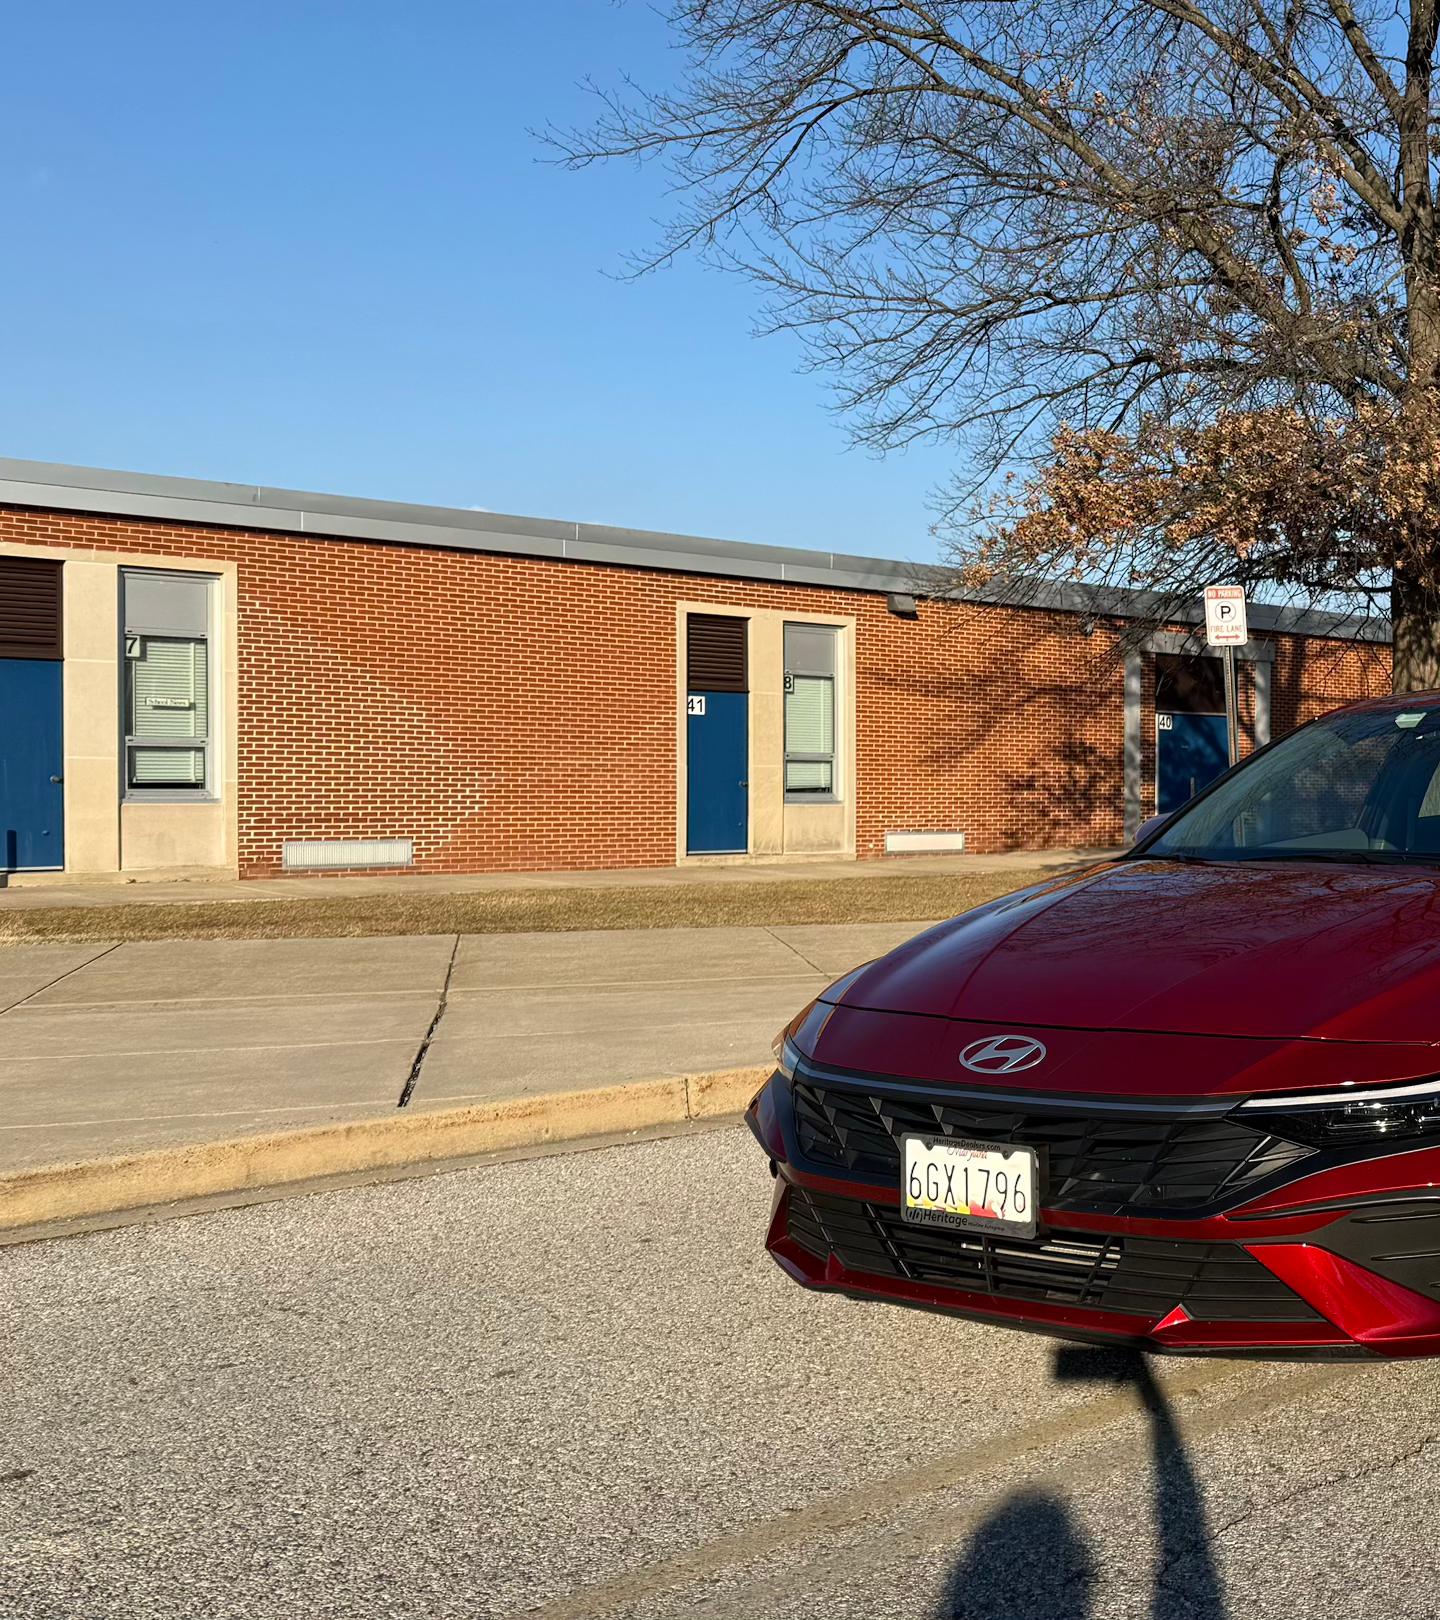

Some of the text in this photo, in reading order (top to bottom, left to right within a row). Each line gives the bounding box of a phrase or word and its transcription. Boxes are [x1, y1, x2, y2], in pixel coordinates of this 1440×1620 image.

[1207, 589, 1216, 598] NO
[1220, 605, 1231, 619] P
[1226, 624, 1242, 632] LANE
[125, 637, 138, 654] 7
[783, 676, 792, 689] 8
[688, 698, 703, 712] 41
[1159, 715, 1171, 728] 40
[909, 1161, 1026, 1214] 6GX1796
[923, 1209, 968, 1228] Heritage
